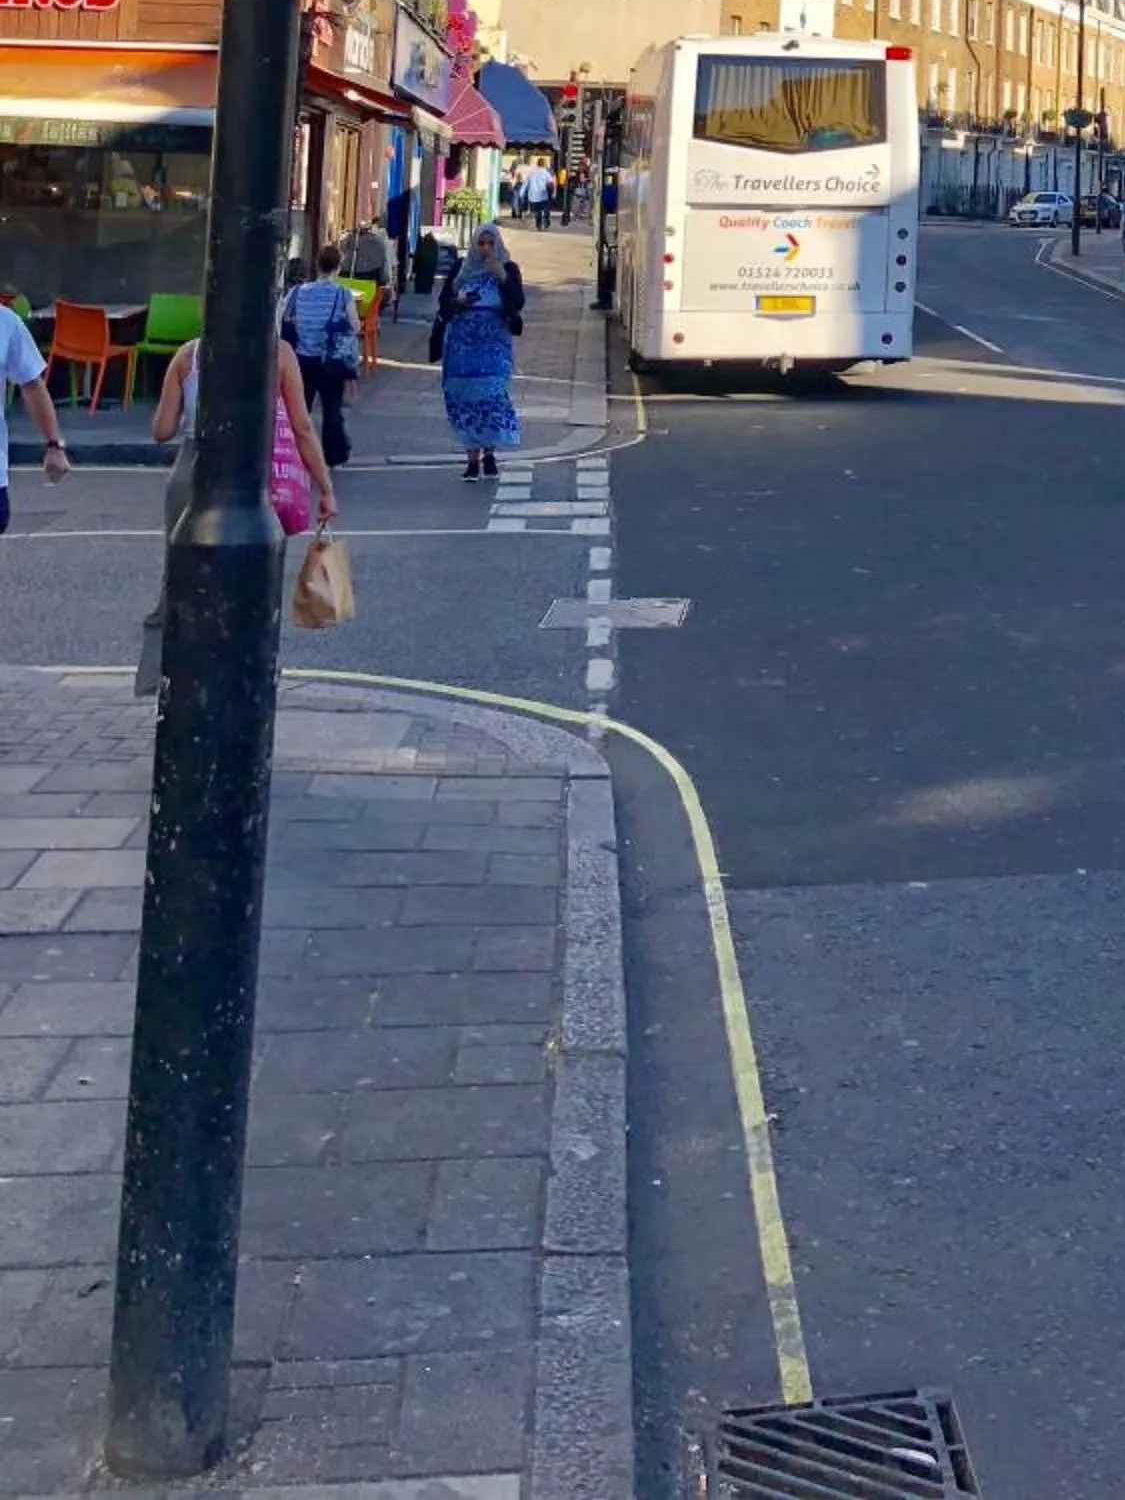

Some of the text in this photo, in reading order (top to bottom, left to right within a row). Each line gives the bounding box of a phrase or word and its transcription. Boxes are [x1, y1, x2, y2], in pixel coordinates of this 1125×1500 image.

[733, 174, 822, 192] Travellers
[825, 175, 881, 193] Choice
[719, 215, 770, 230] Quality
[773, 215, 812, 229] Coach
